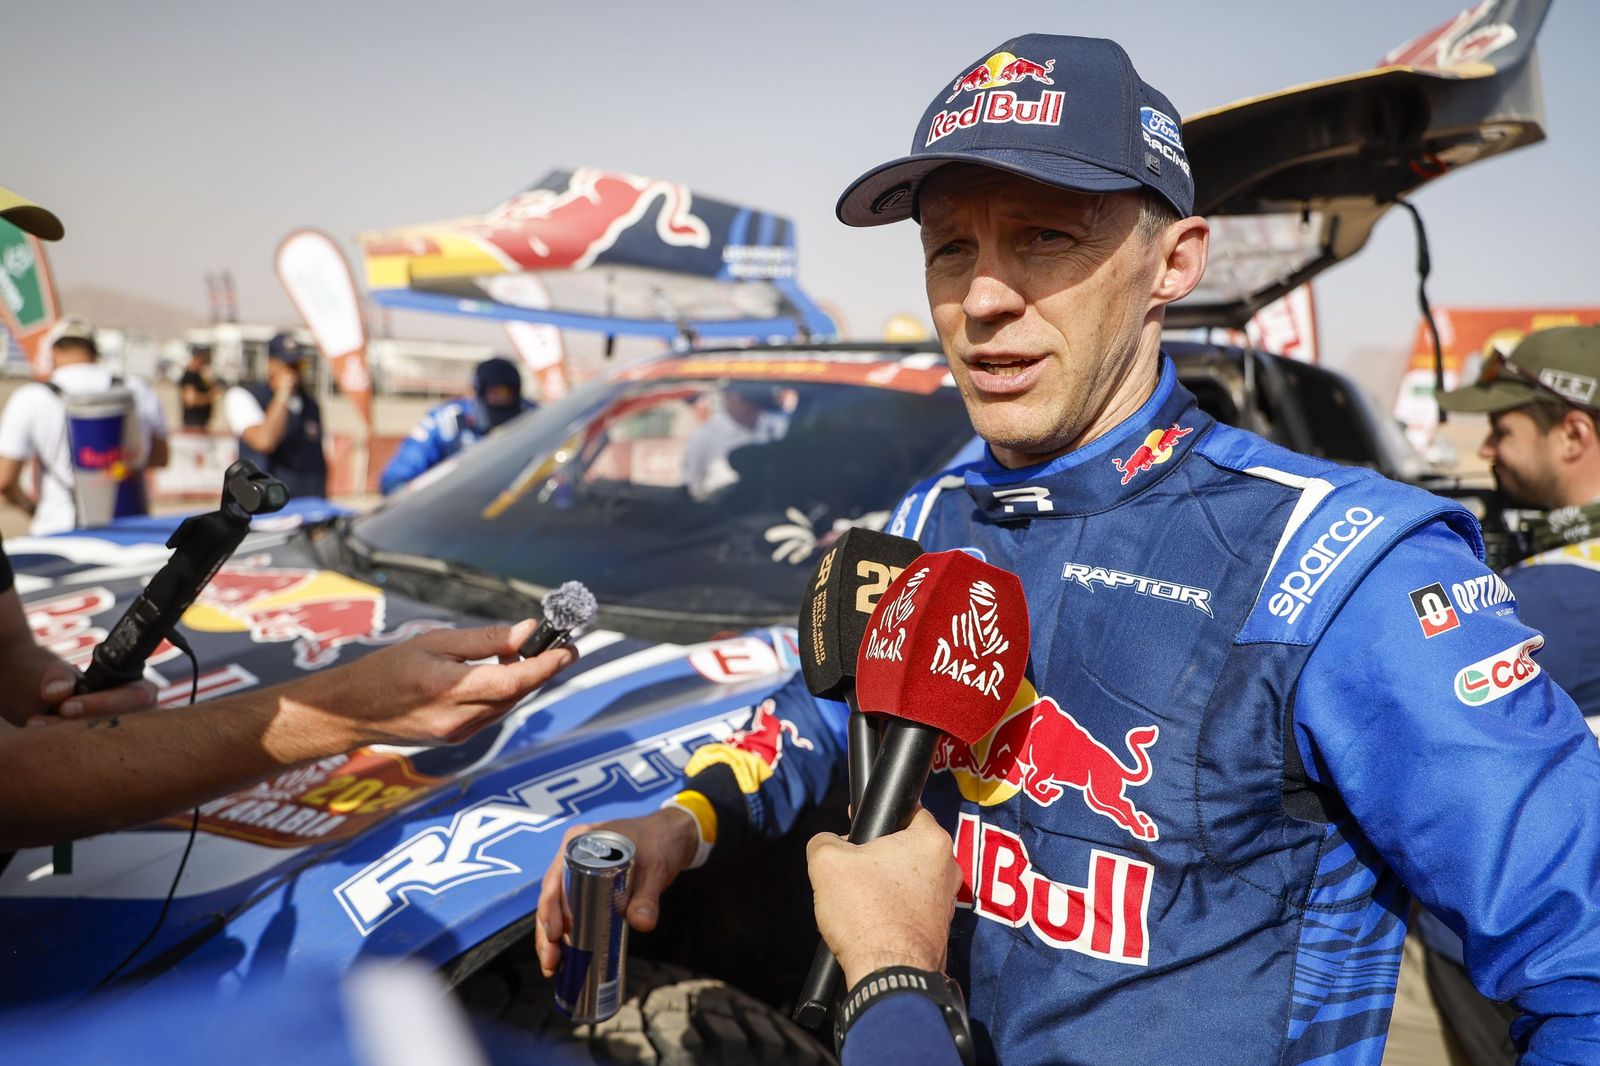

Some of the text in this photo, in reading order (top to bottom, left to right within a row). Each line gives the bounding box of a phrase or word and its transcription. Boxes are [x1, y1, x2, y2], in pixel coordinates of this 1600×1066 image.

[926, 91, 1064, 146] Red Bull
[1149, 113, 1181, 146] Ford
[856, 560, 905, 614] 2
[1061, 562, 1213, 619] RAPTOR
[1268, 506, 1375, 622] sparco
[866, 628, 906, 662] DAKAR
[930, 637, 1005, 701] DAKAR
[976, 824, 1153, 963] Bull
